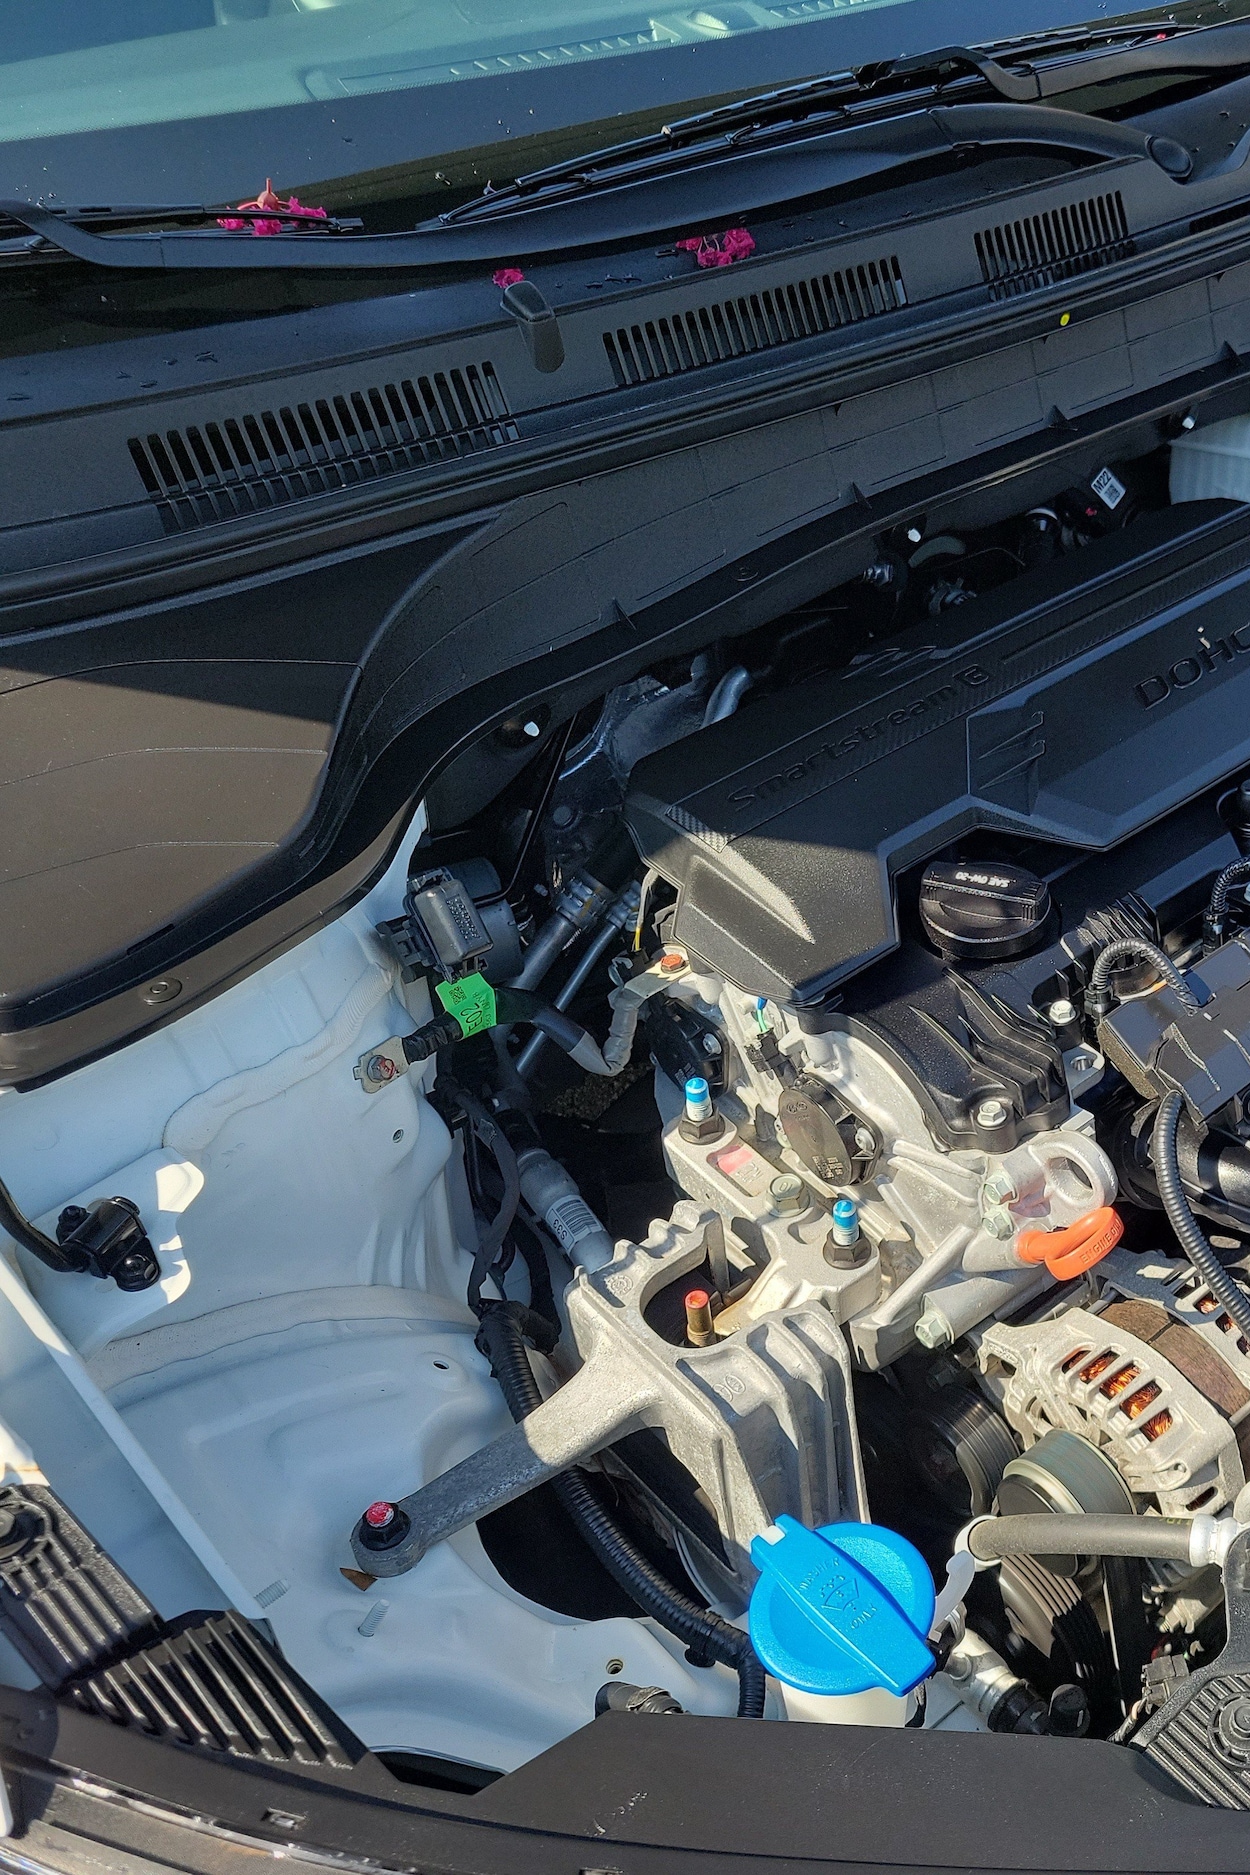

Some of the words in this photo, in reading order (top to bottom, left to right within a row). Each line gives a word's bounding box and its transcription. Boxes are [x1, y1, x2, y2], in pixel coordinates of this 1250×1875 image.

[1093, 471, 1112, 493] M22
[728, 684, 957, 812] Smartstream
[955, 871, 989, 885] 0W-20
[988, 876, 1010, 888] SAE
[1080, 1233, 1112, 1264] ENGINE
